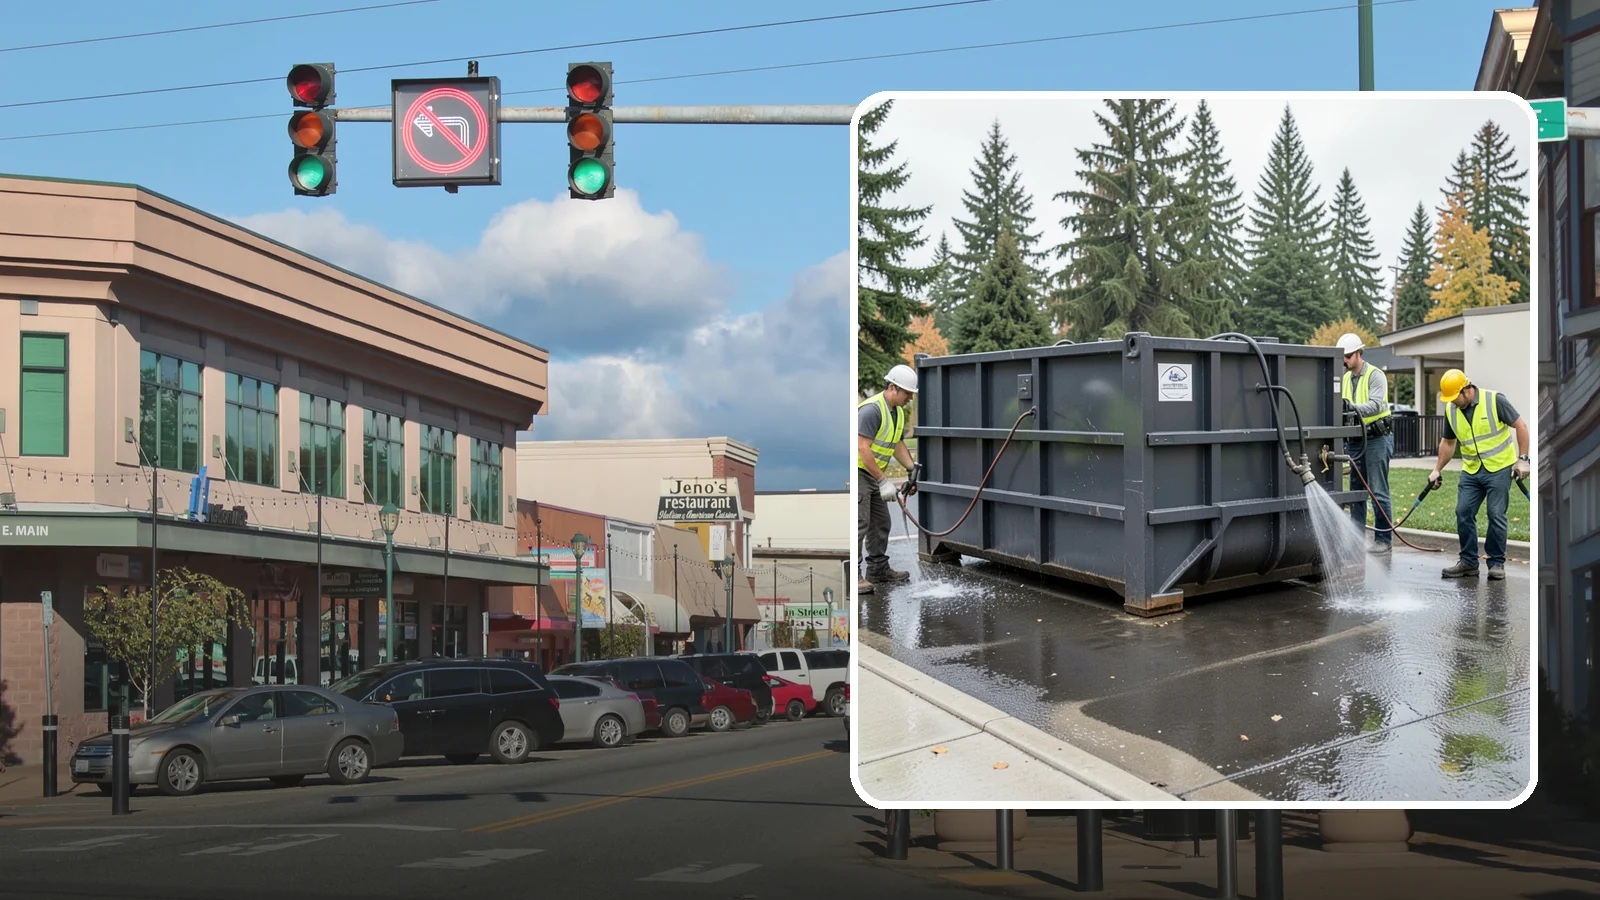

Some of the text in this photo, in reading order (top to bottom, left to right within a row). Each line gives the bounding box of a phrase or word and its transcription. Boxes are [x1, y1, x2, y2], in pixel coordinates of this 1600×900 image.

[670, 480, 728, 494] Jeno's
[665, 496, 731, 509] restaurant
[658, 510, 682, 519] Italian
[686, 509, 715, 519] American
[715, 509, 737, 519] Cuisine
[2, 525, 49, 536] E. MAIN
[786, 607, 828, 616] in Street
[791, 619, 824, 627] lass
